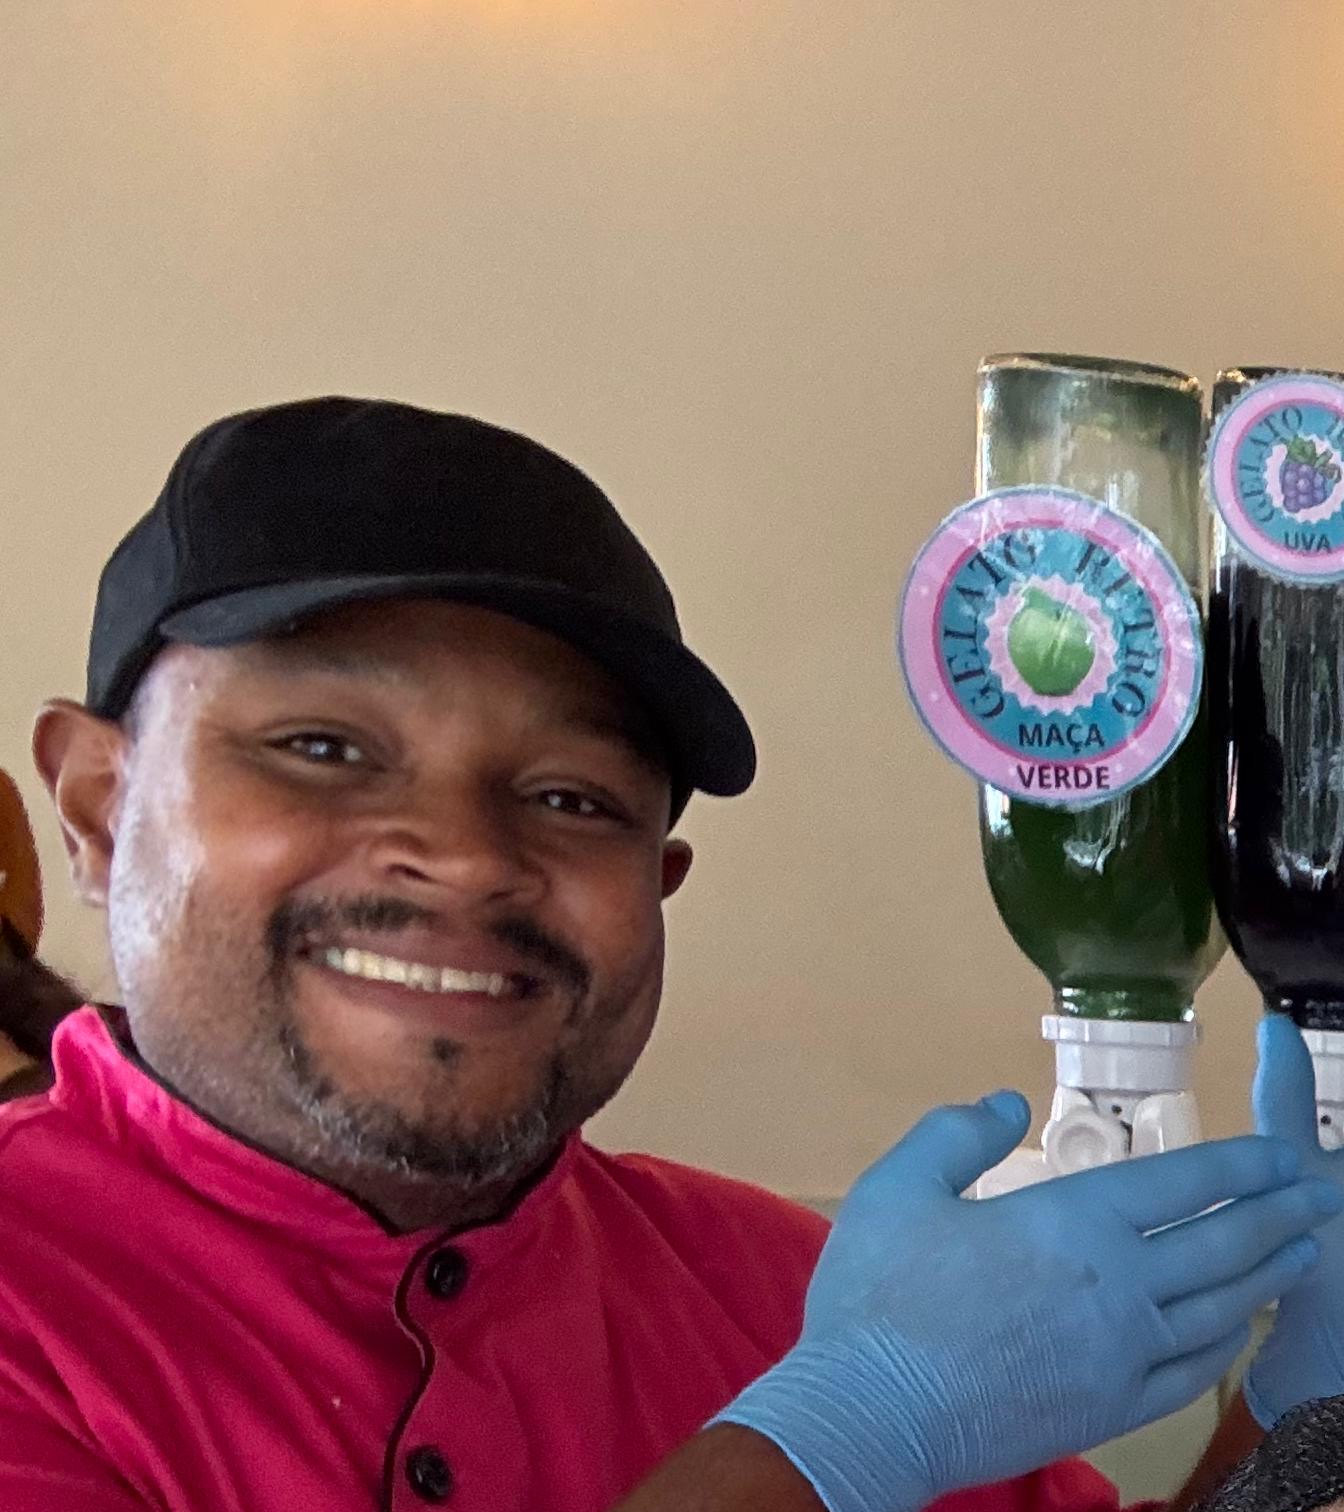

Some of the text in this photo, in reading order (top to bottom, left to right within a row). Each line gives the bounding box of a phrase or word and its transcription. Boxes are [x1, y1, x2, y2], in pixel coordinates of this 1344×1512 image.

[1239, 406, 1303, 523] GELATO
[1284, 531, 1333, 554] UVA
[944, 534, 1039, 719] GELATO
[1018, 723, 1105, 754] MAÇA
[1017, 765, 1111, 789] VERDE
